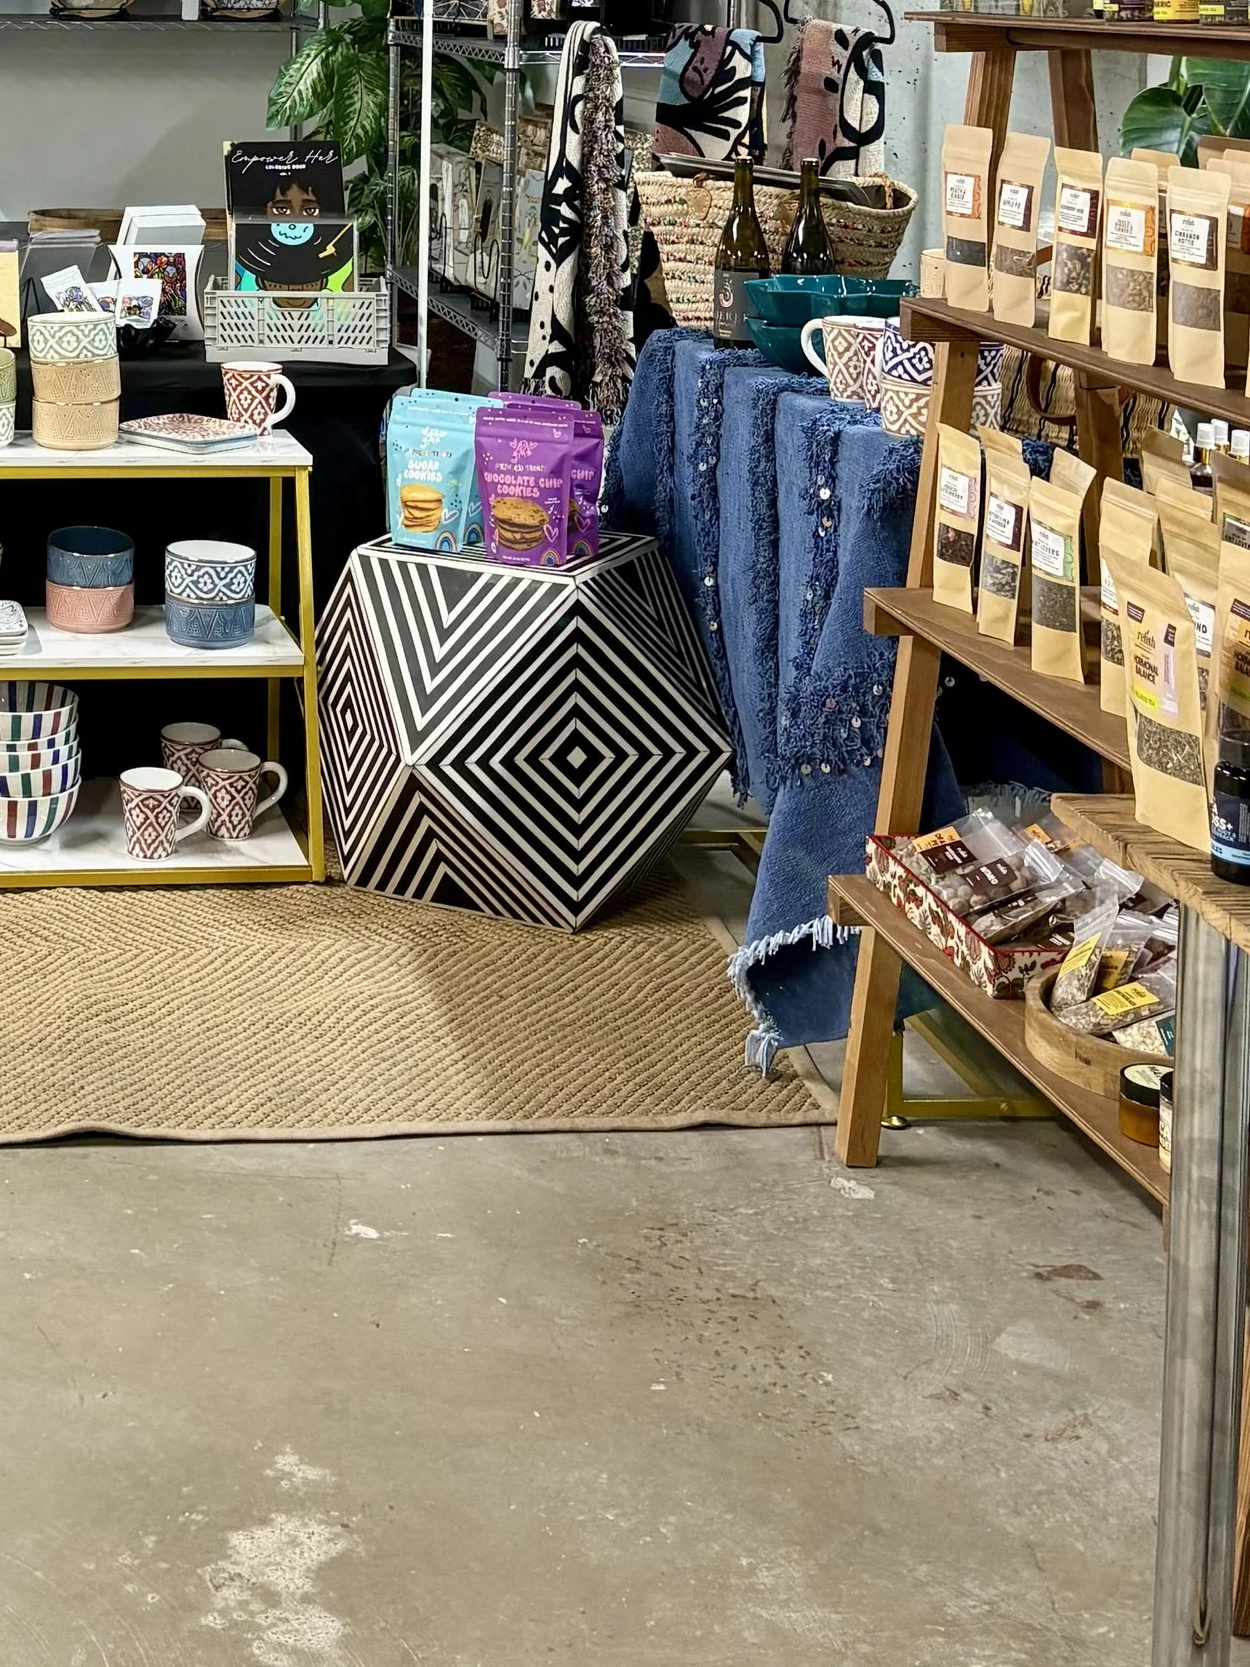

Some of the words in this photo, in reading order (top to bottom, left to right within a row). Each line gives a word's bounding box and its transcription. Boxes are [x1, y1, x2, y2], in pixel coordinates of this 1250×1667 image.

[231, 149, 299, 174] Empower
[304, 149, 339, 164] Her
[407, 459, 440, 471] SUGAR
[403, 468, 443, 483] COOKIES
[484, 472, 536, 487] CHOCOLATE
[538, 477, 564, 489] CHIP
[570, 469, 595, 481] CHIP
[496, 484, 540, 498] COOKIES
[1137, 630, 1156, 650] relish
